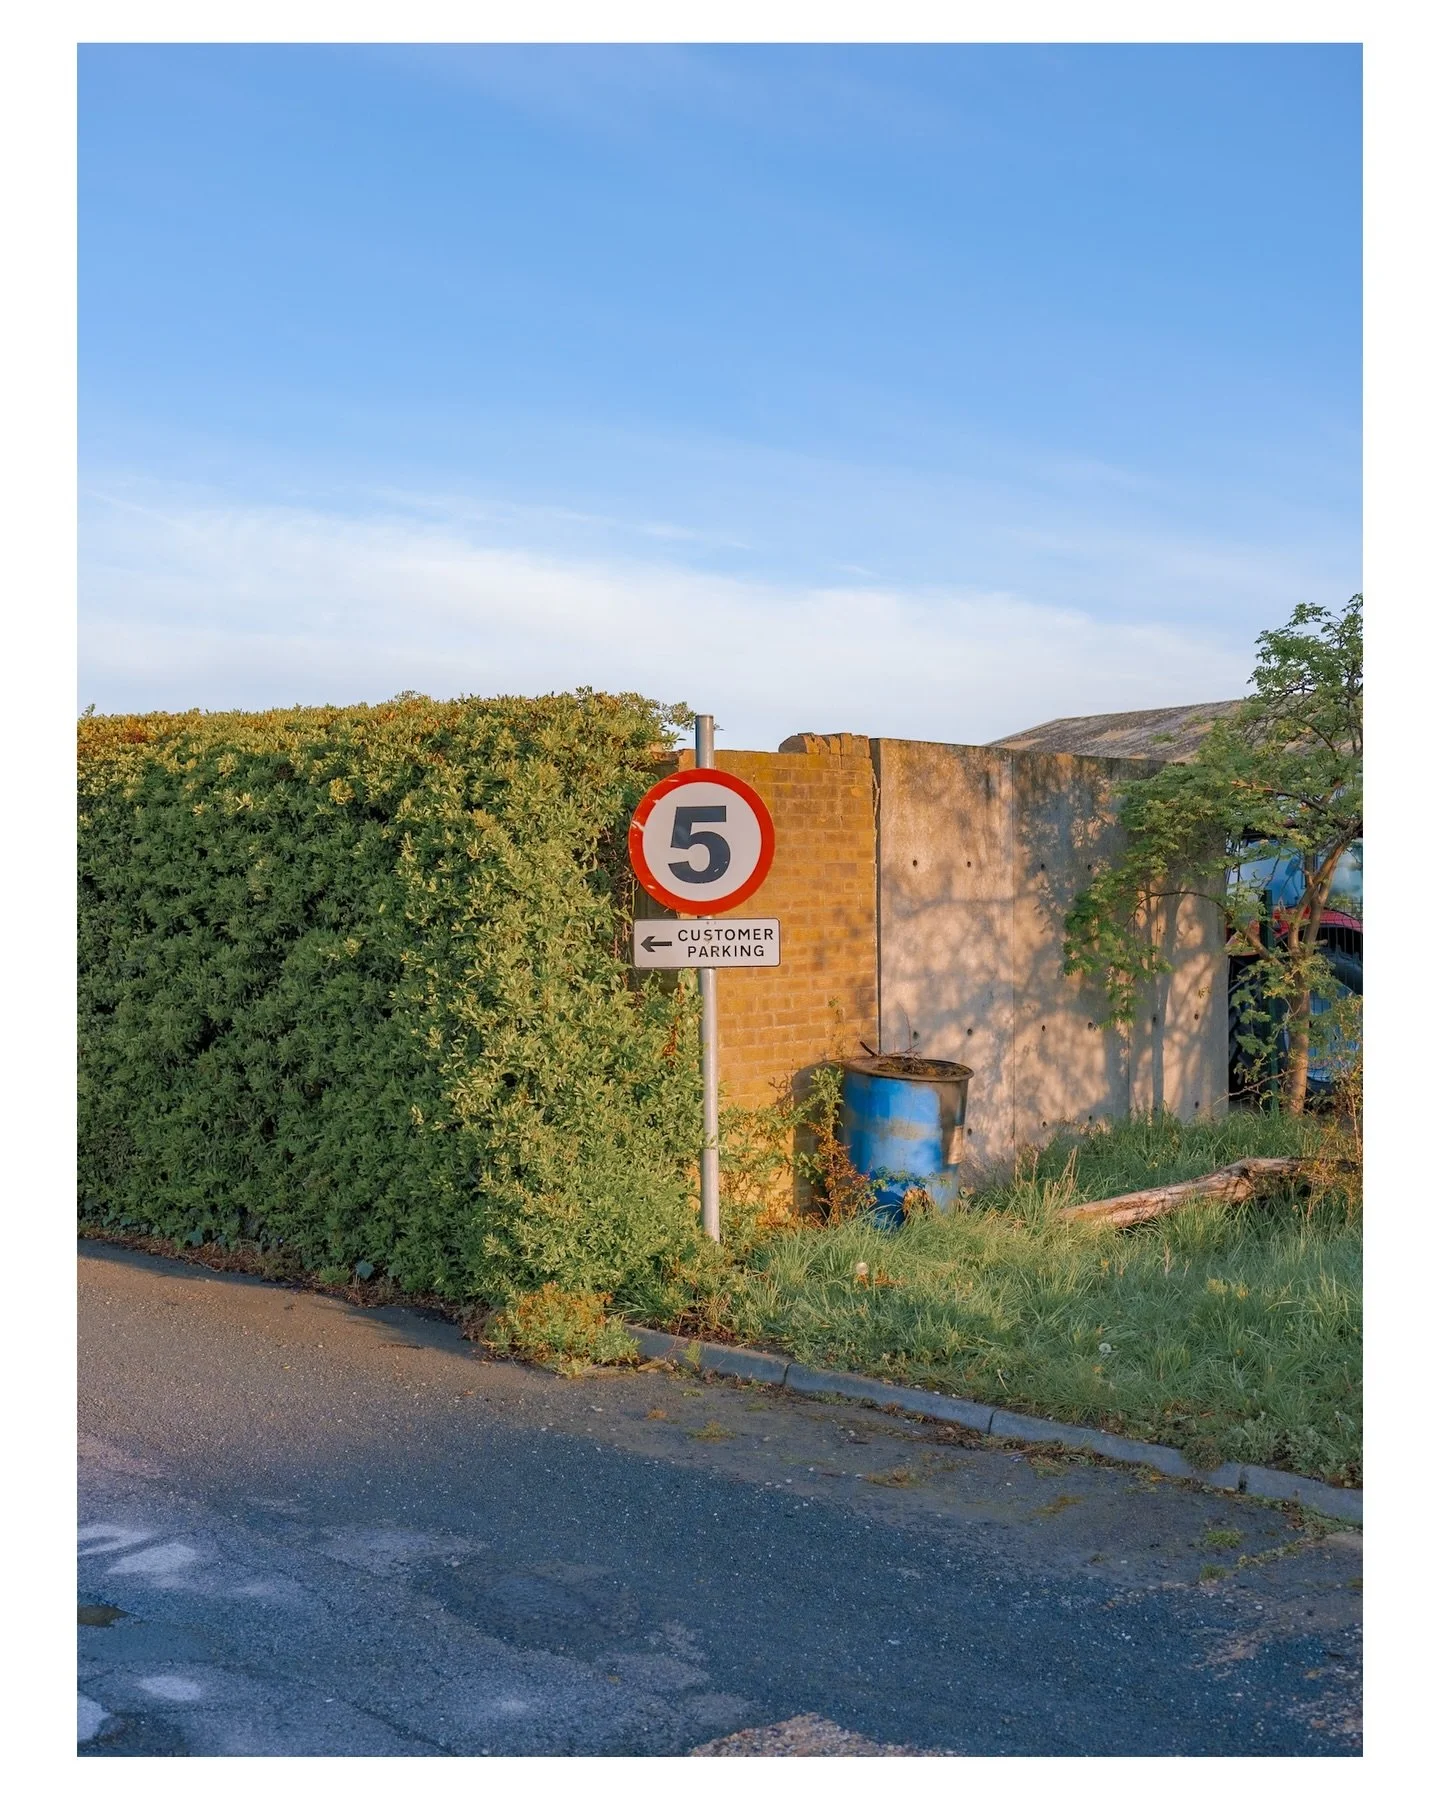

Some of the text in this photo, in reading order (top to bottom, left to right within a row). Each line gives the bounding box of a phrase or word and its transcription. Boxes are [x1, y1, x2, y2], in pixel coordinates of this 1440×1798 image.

[668, 805, 731, 884] 5
[677, 928, 774, 941] CUSTOMER
[687, 945, 765, 957] PARKING
